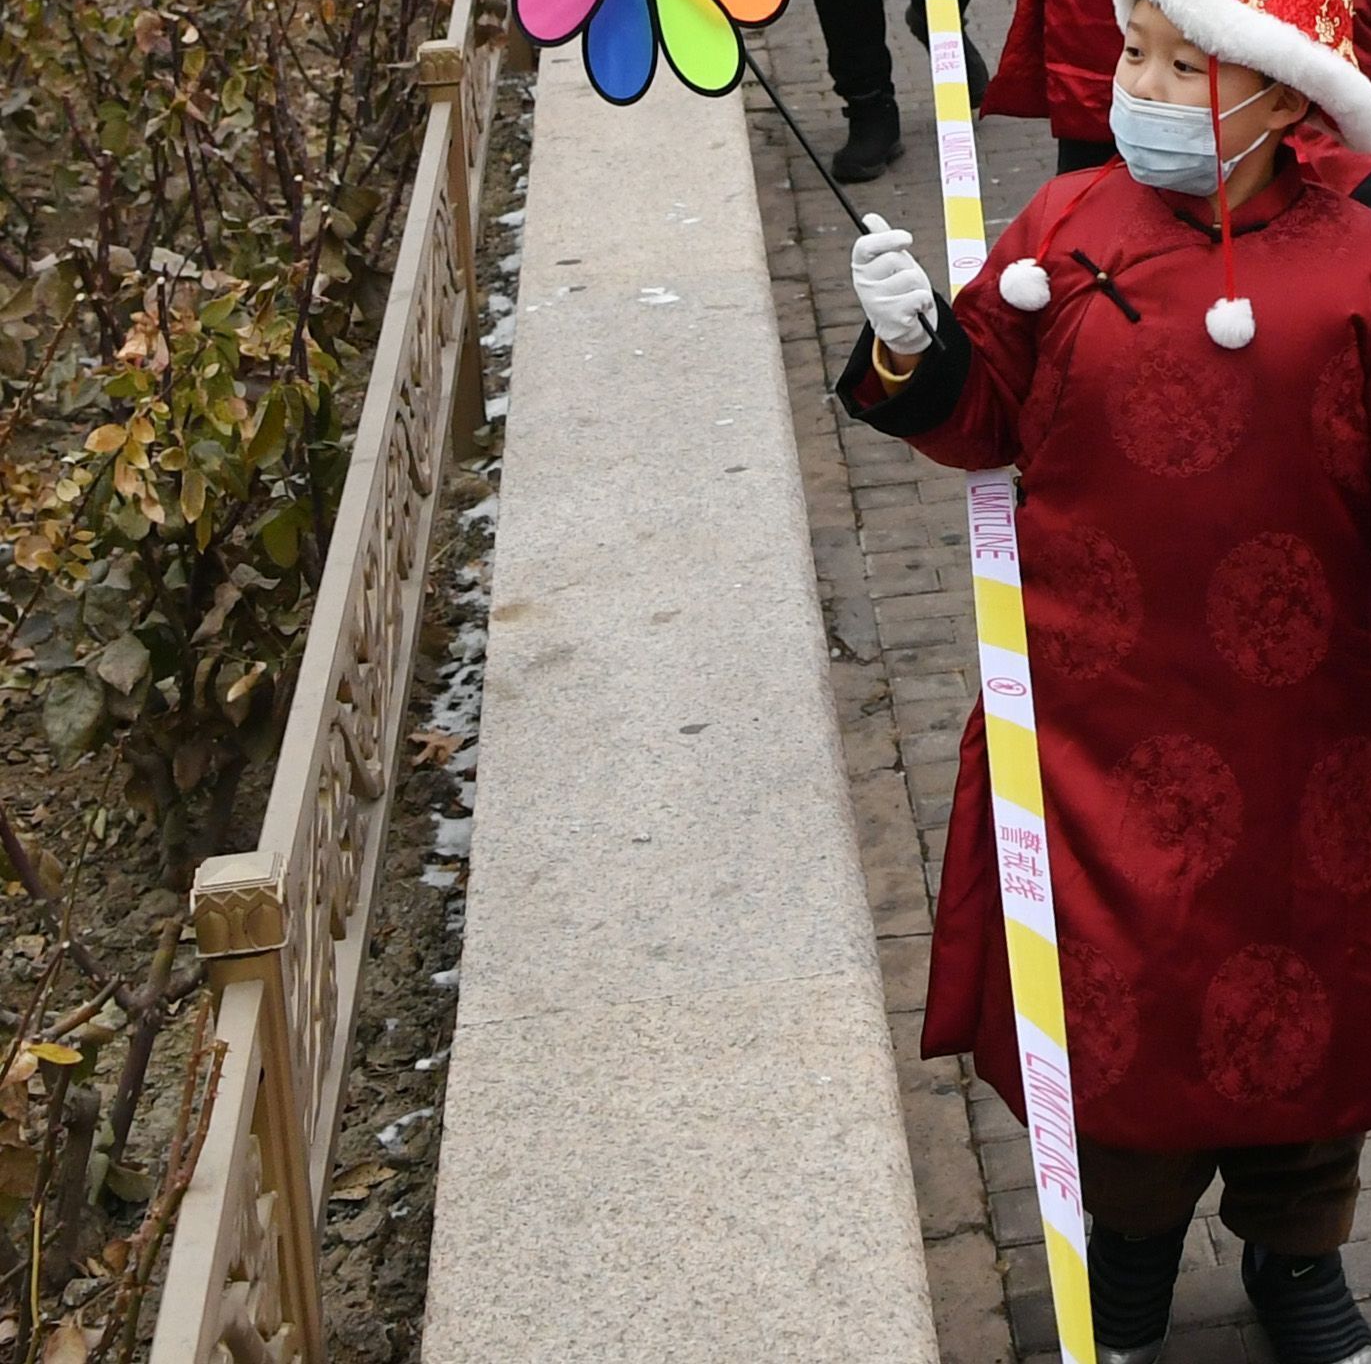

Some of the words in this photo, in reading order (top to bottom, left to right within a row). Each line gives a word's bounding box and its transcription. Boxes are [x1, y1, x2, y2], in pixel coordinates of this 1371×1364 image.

[1000, 823, 1046, 903] 警戒线
[1025, 1050, 1082, 1219] LIMITLINE
